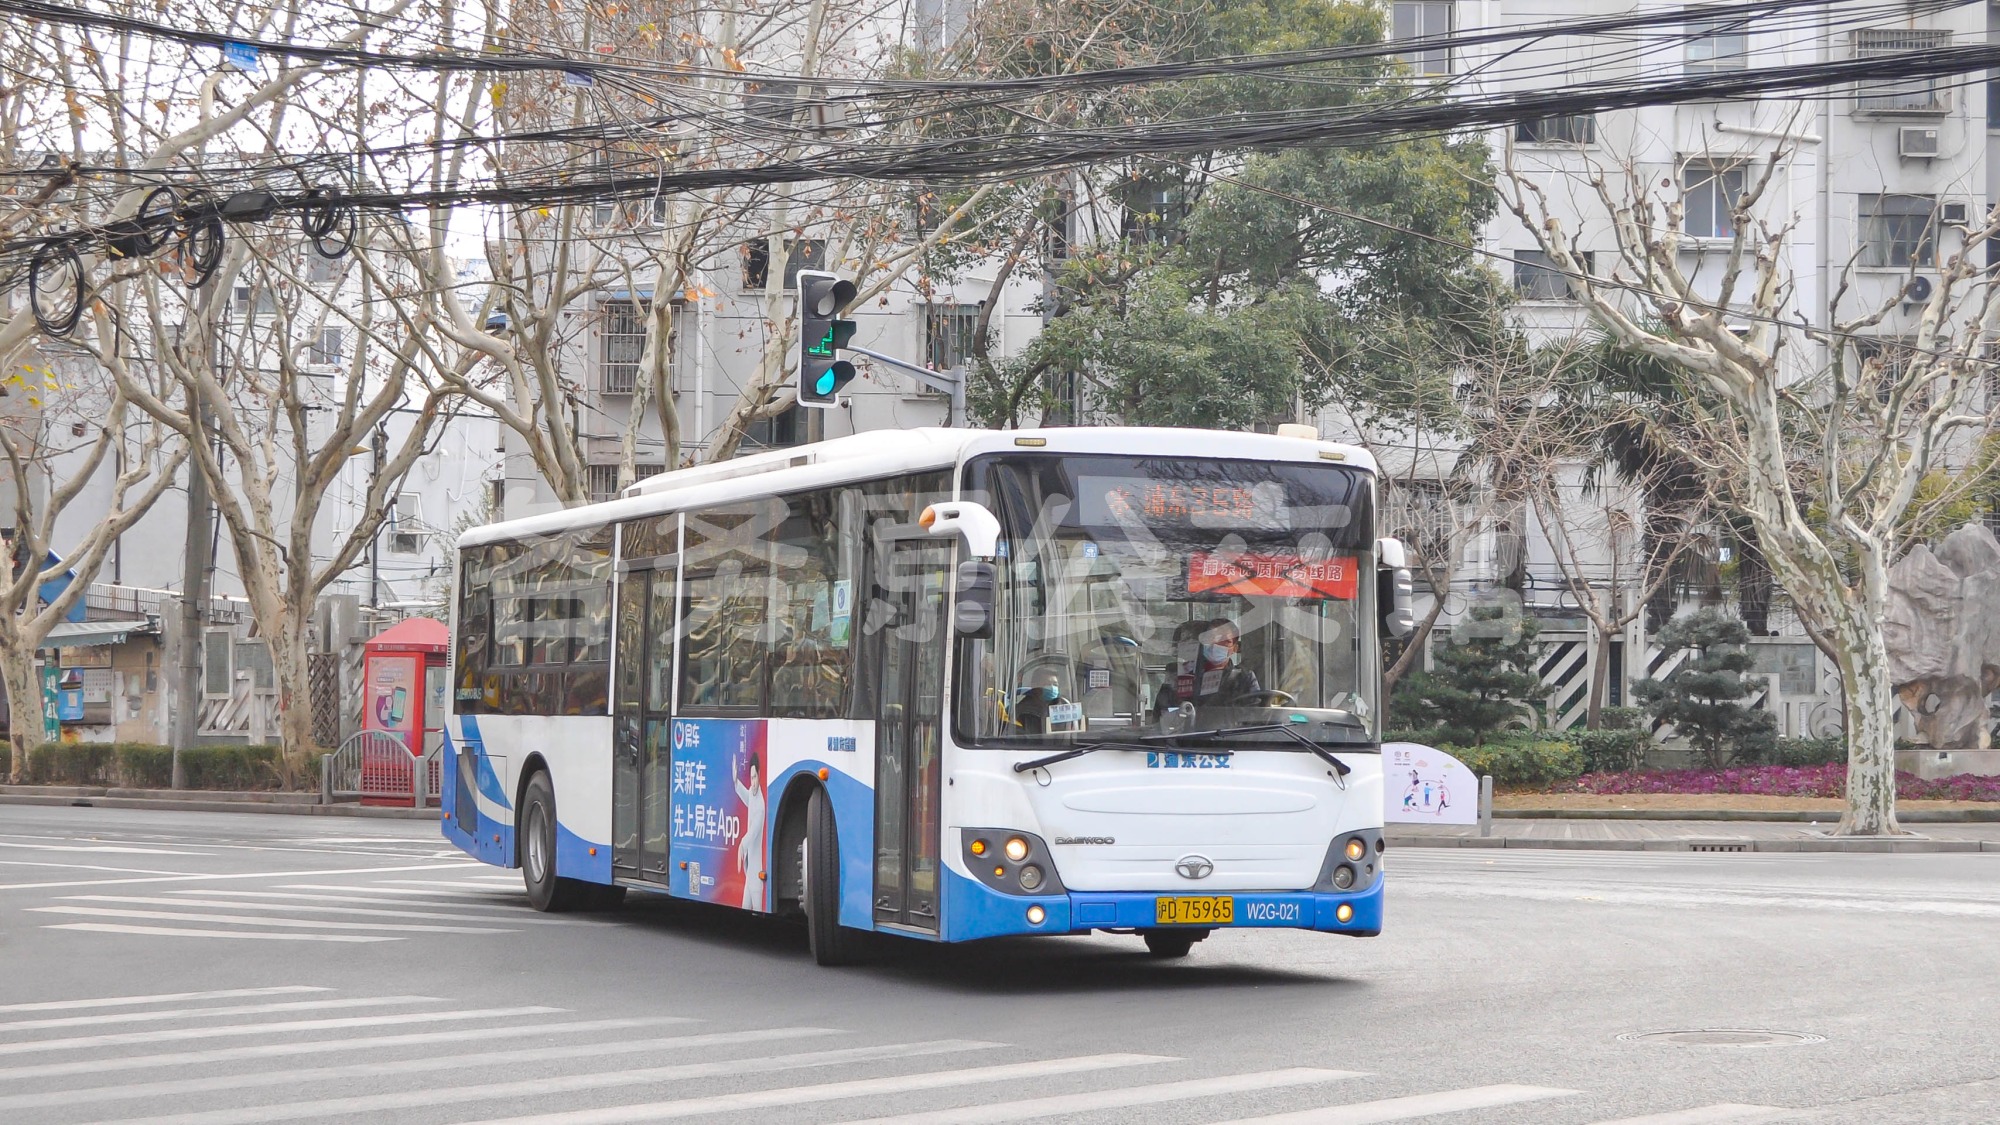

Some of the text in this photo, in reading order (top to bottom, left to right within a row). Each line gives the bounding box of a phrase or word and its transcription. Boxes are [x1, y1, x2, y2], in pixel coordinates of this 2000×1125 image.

[1203, 559, 1343, 581] 浦东优质服务线路
[685, 723, 700, 748] 易车
[674, 760, 707, 796] 买新车
[674, 803, 740, 846] 先上易车App
[1055, 836, 1115, 845] DAEWOO
[1247, 903, 1300, 920] W2G-021
